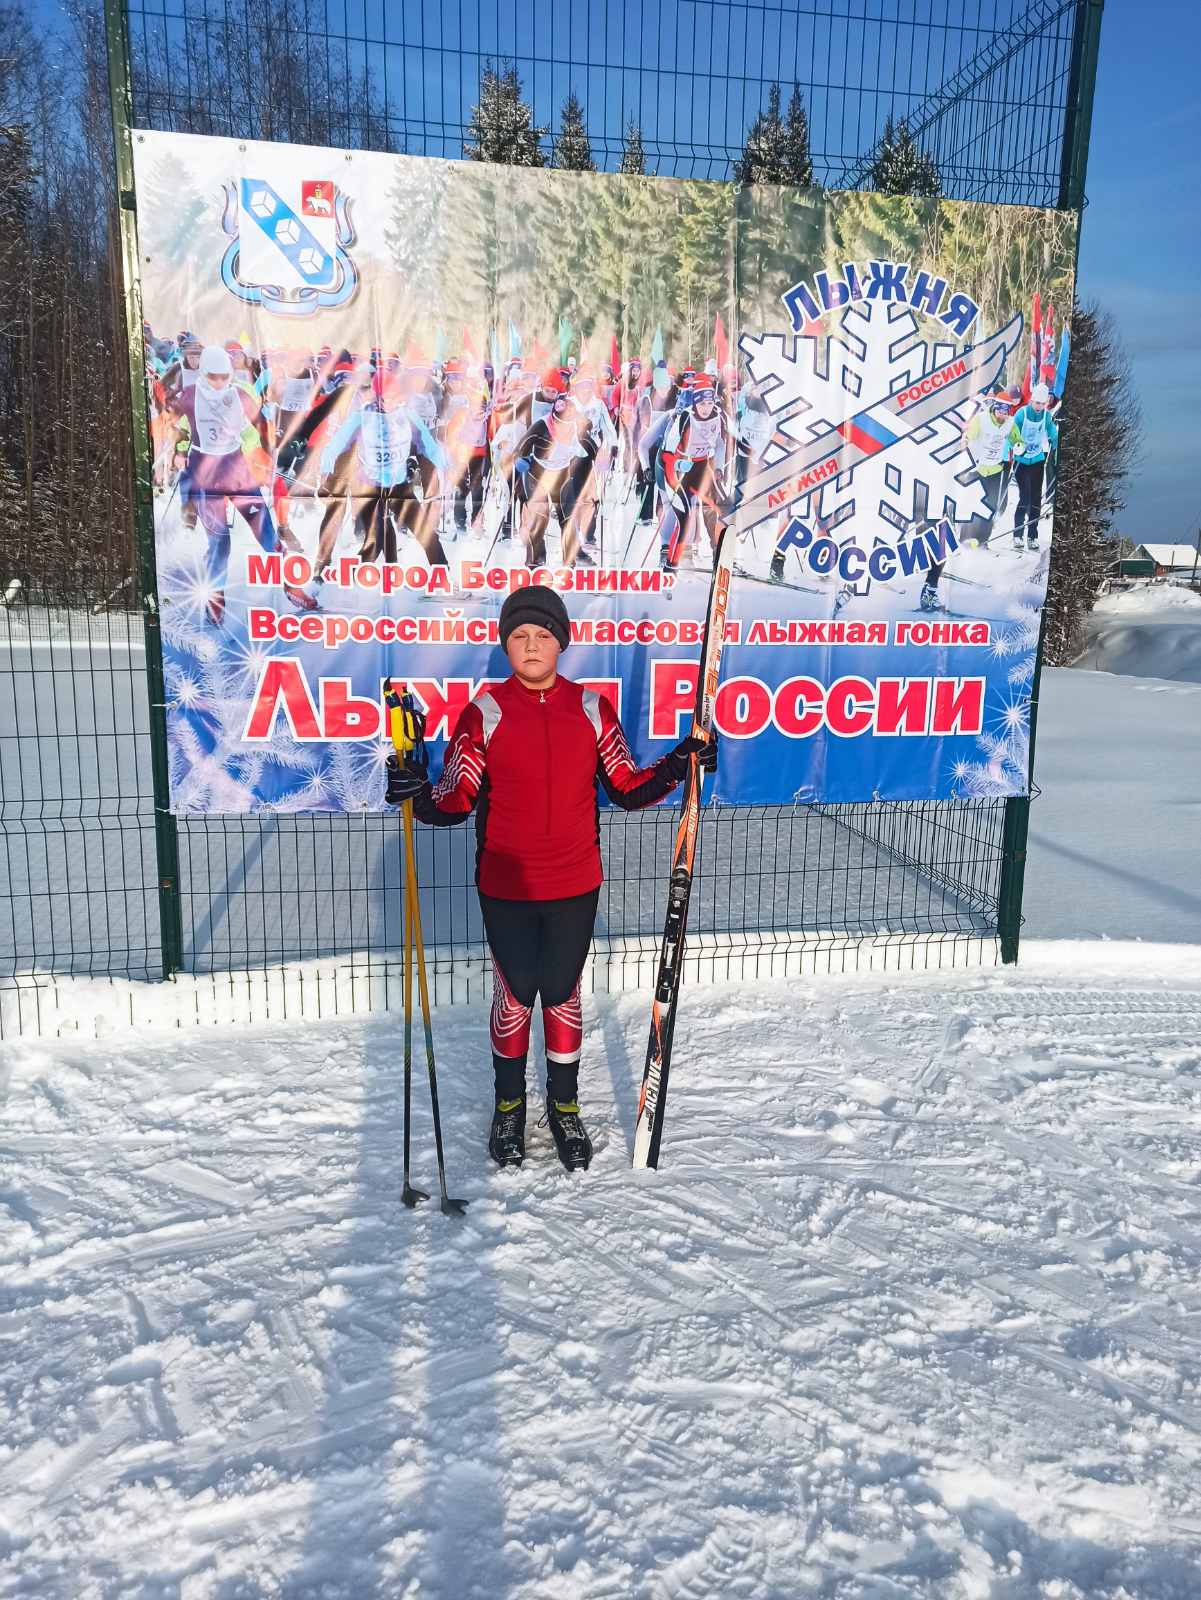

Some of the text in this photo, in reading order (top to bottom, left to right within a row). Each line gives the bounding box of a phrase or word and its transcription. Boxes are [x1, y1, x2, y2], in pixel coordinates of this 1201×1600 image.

[781, 260, 981, 338] ЛЫЖНЯ
[897, 360, 968, 408] РОССИИ
[247, 554, 677, 593] МО «Город Березники»
[776, 518, 960, 582] РОССИИ
[249, 608, 501, 648] Всероссийс
[748, 618, 888, 646] лыжная
[894, 620, 991, 646] гонка
[648, 658, 987, 740] России
